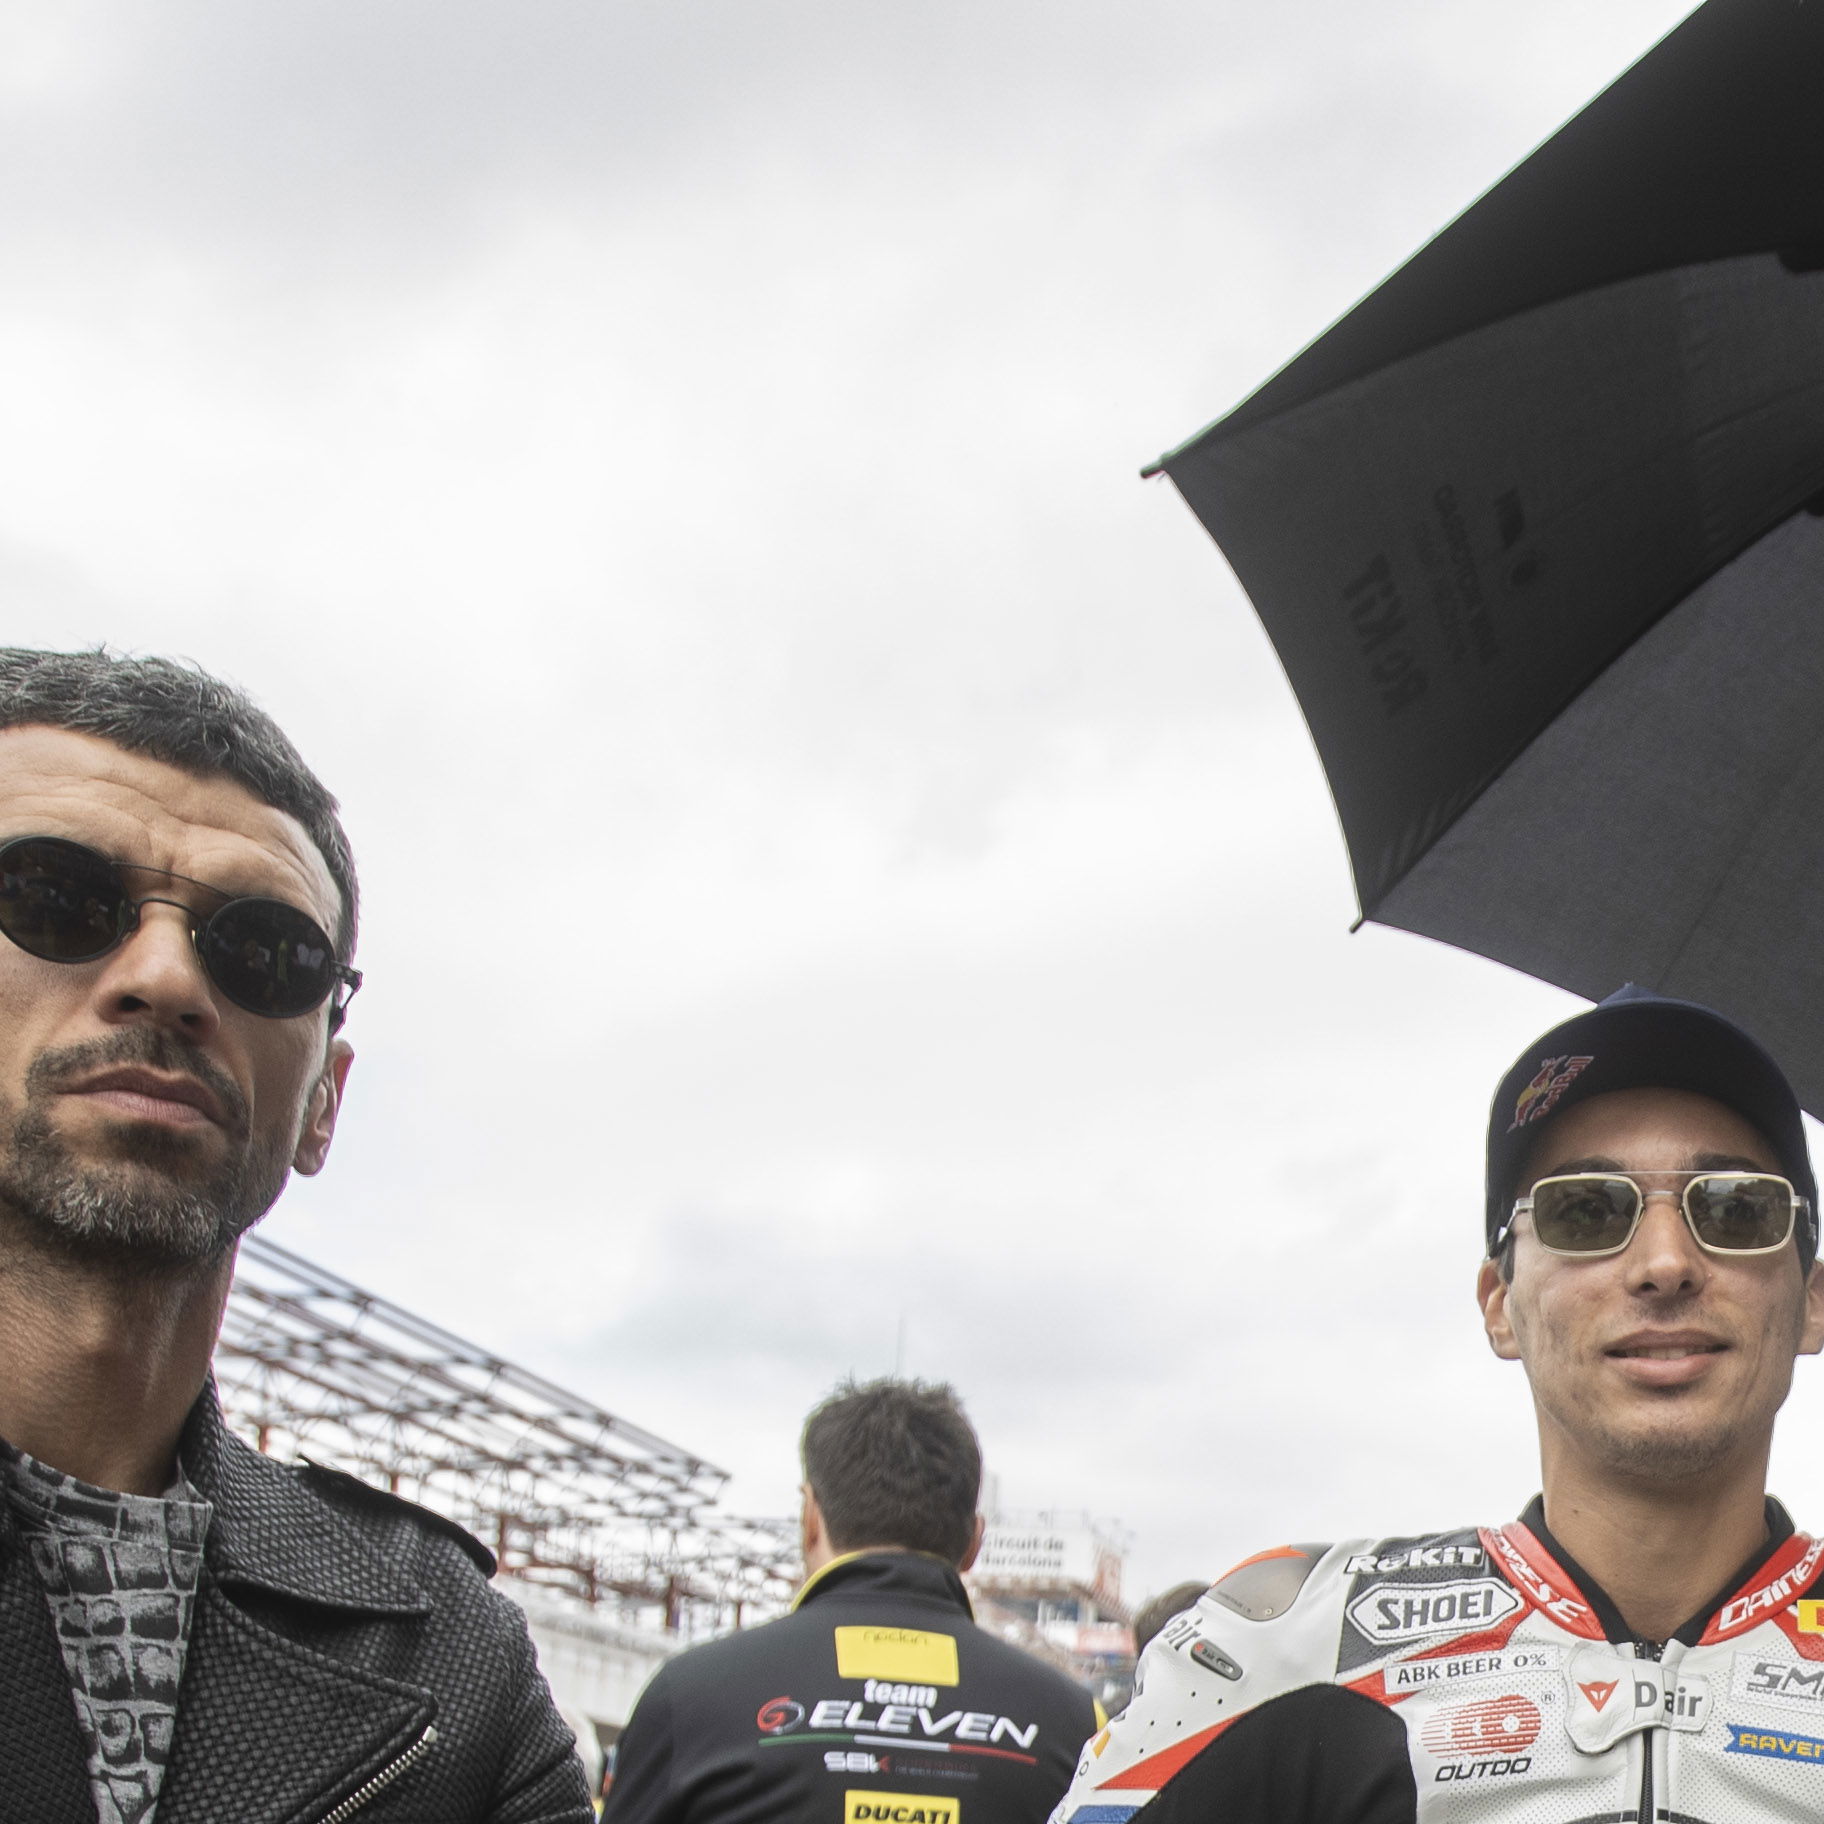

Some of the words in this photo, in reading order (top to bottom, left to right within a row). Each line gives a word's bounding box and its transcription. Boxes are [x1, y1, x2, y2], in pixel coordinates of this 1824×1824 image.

[1376, 1588, 1495, 1632] SHOEI
[1396, 1665, 1442, 1686] ABK
[1446, 1656, 1503, 1679] BEER
[1513, 1652, 1548, 1668] 0%
[864, 1677, 938, 1708] team
[808, 1700, 1040, 1750] ELEVEN
[823, 1751, 891, 1774] SBK
[1434, 1757, 1532, 1783] OUTDO
